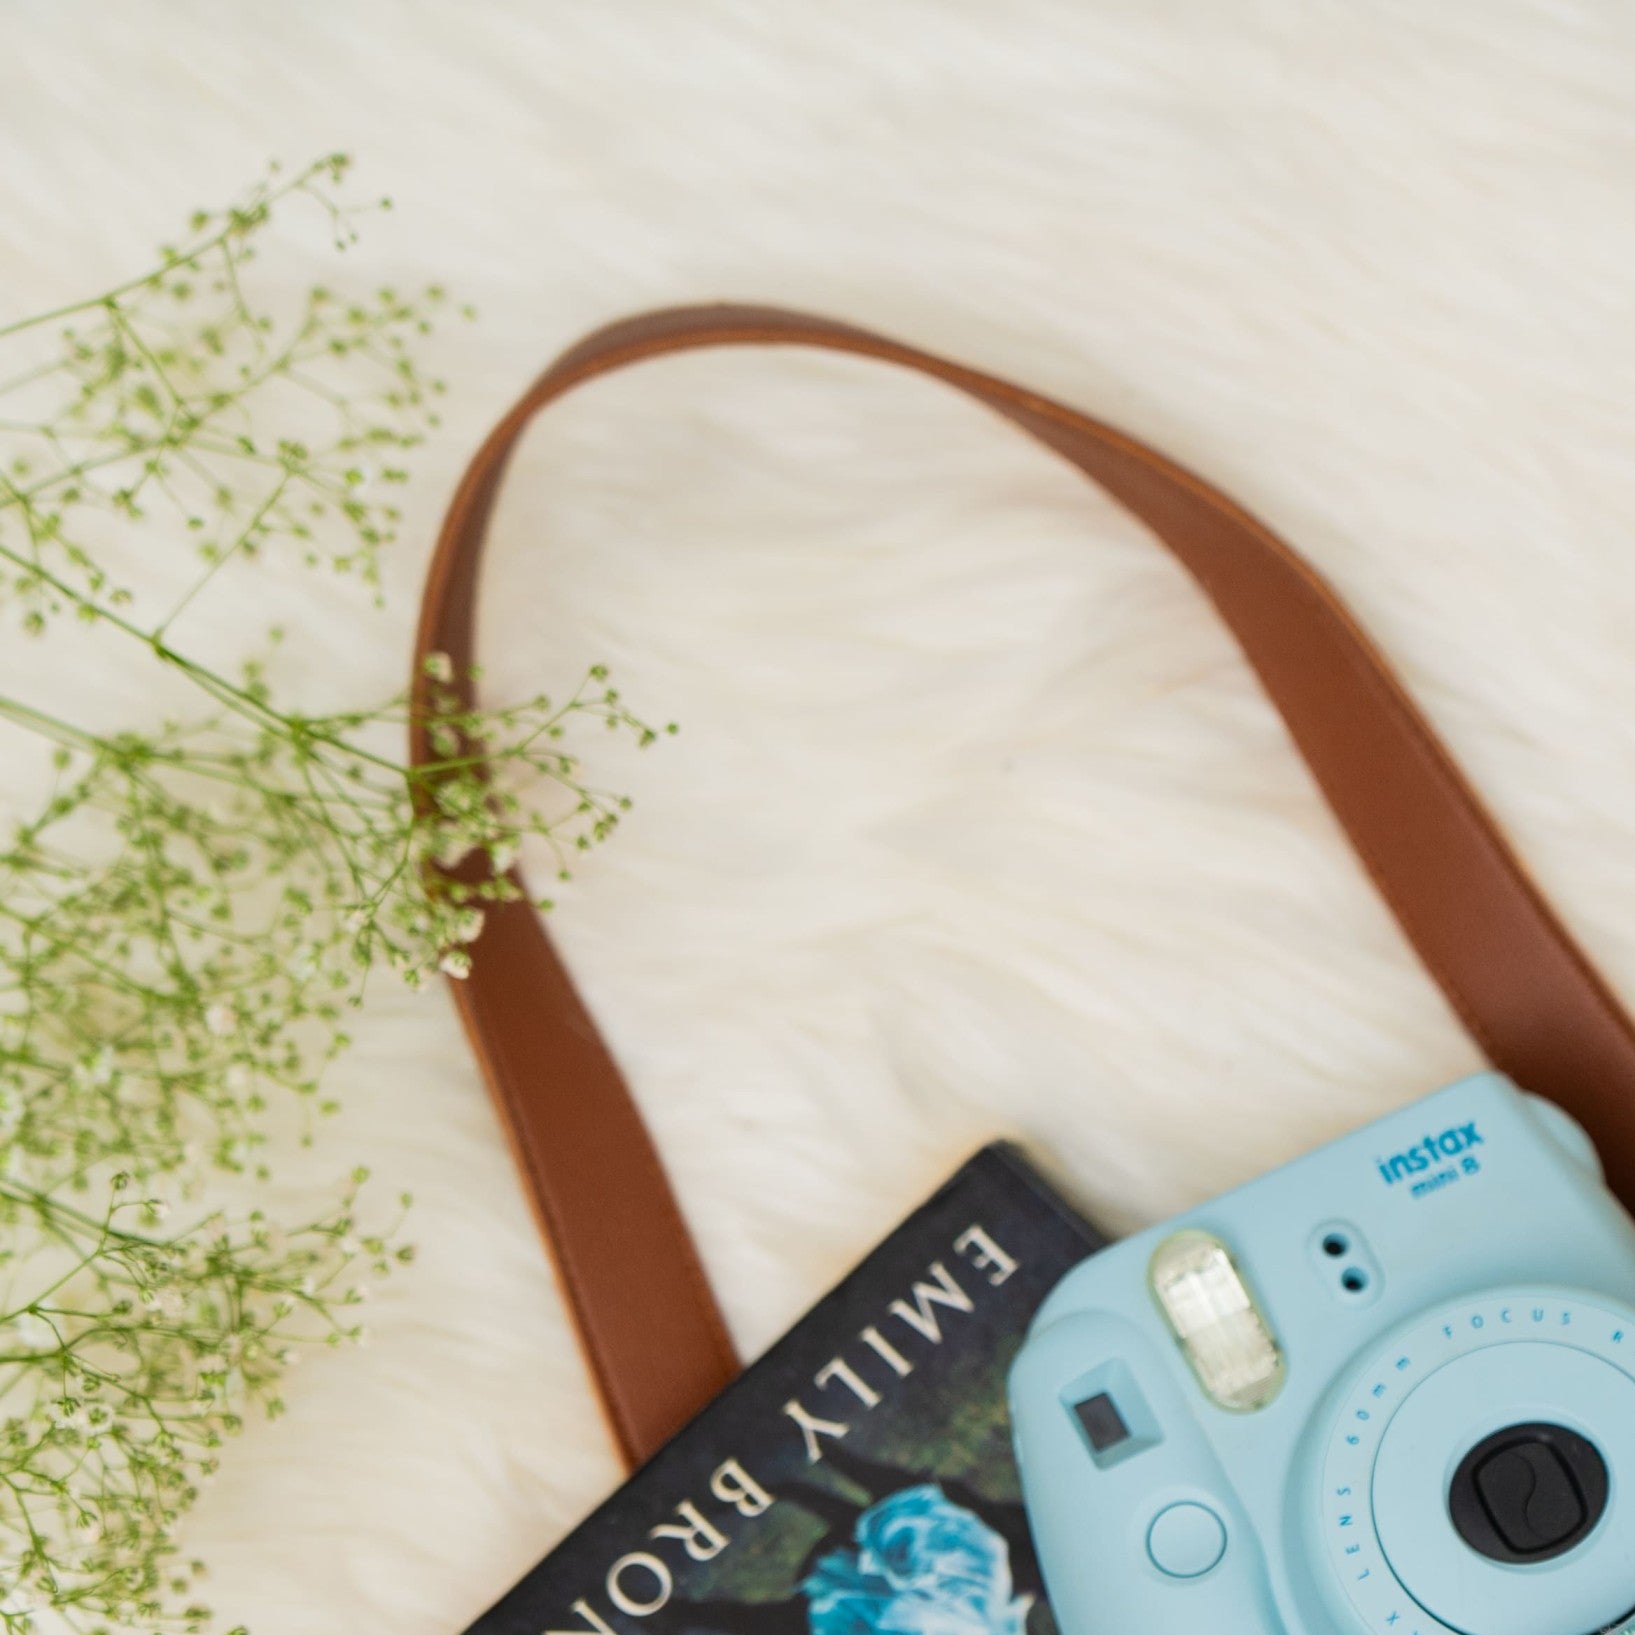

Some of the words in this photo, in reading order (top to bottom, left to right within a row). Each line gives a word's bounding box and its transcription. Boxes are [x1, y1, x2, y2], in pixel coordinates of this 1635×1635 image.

[1377, 1121, 1483, 1187] instax
[1411, 1164, 1460, 1201] mini
[1459, 1156, 1482, 1178] 8
[782, 1222, 1020, 1462] EMILY
[1442, 1307, 1572, 1339] FOCUS
[1345, 1355, 1411, 1446] 60mm
[1334, 1486, 1371, 1581] LENS
